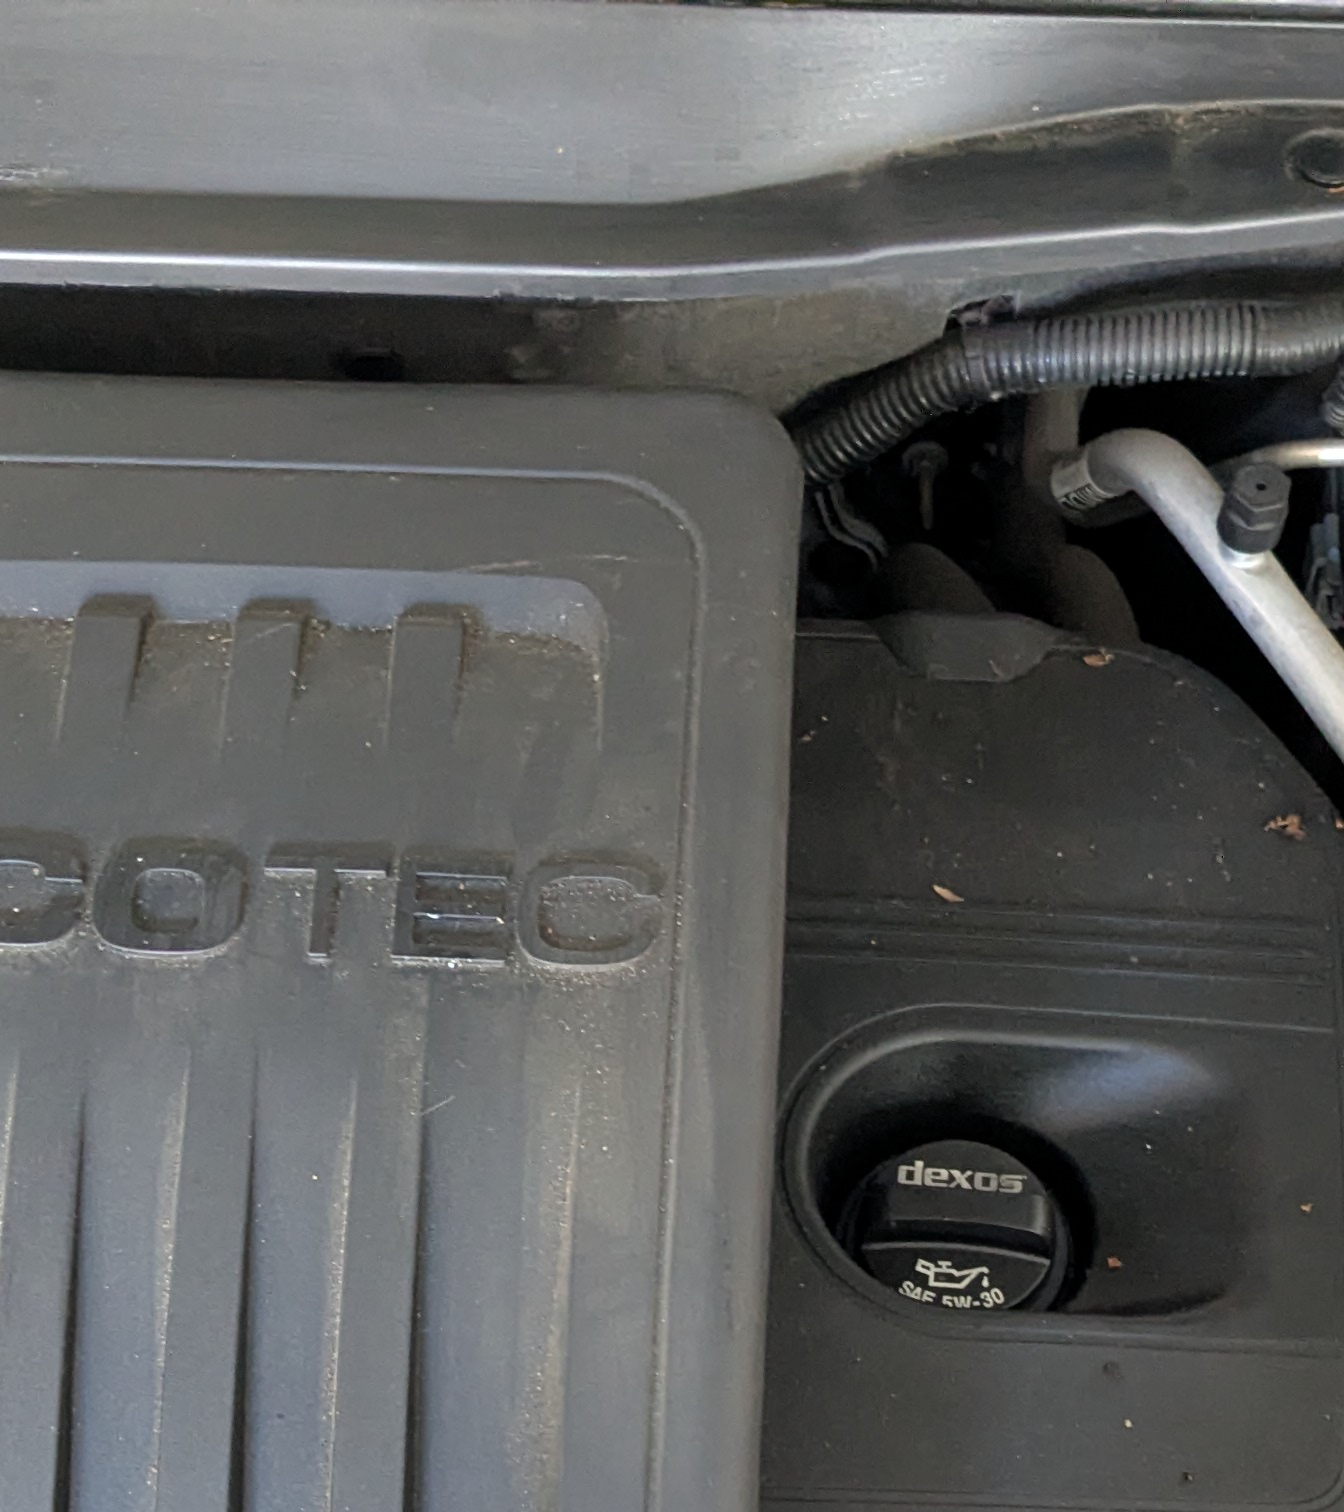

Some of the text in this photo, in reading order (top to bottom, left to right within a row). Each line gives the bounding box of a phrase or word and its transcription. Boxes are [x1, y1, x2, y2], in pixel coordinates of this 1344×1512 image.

[897, 1160, 1024, 1194] dexos
[899, 1281, 1005, 1309] SAE 5W-30
